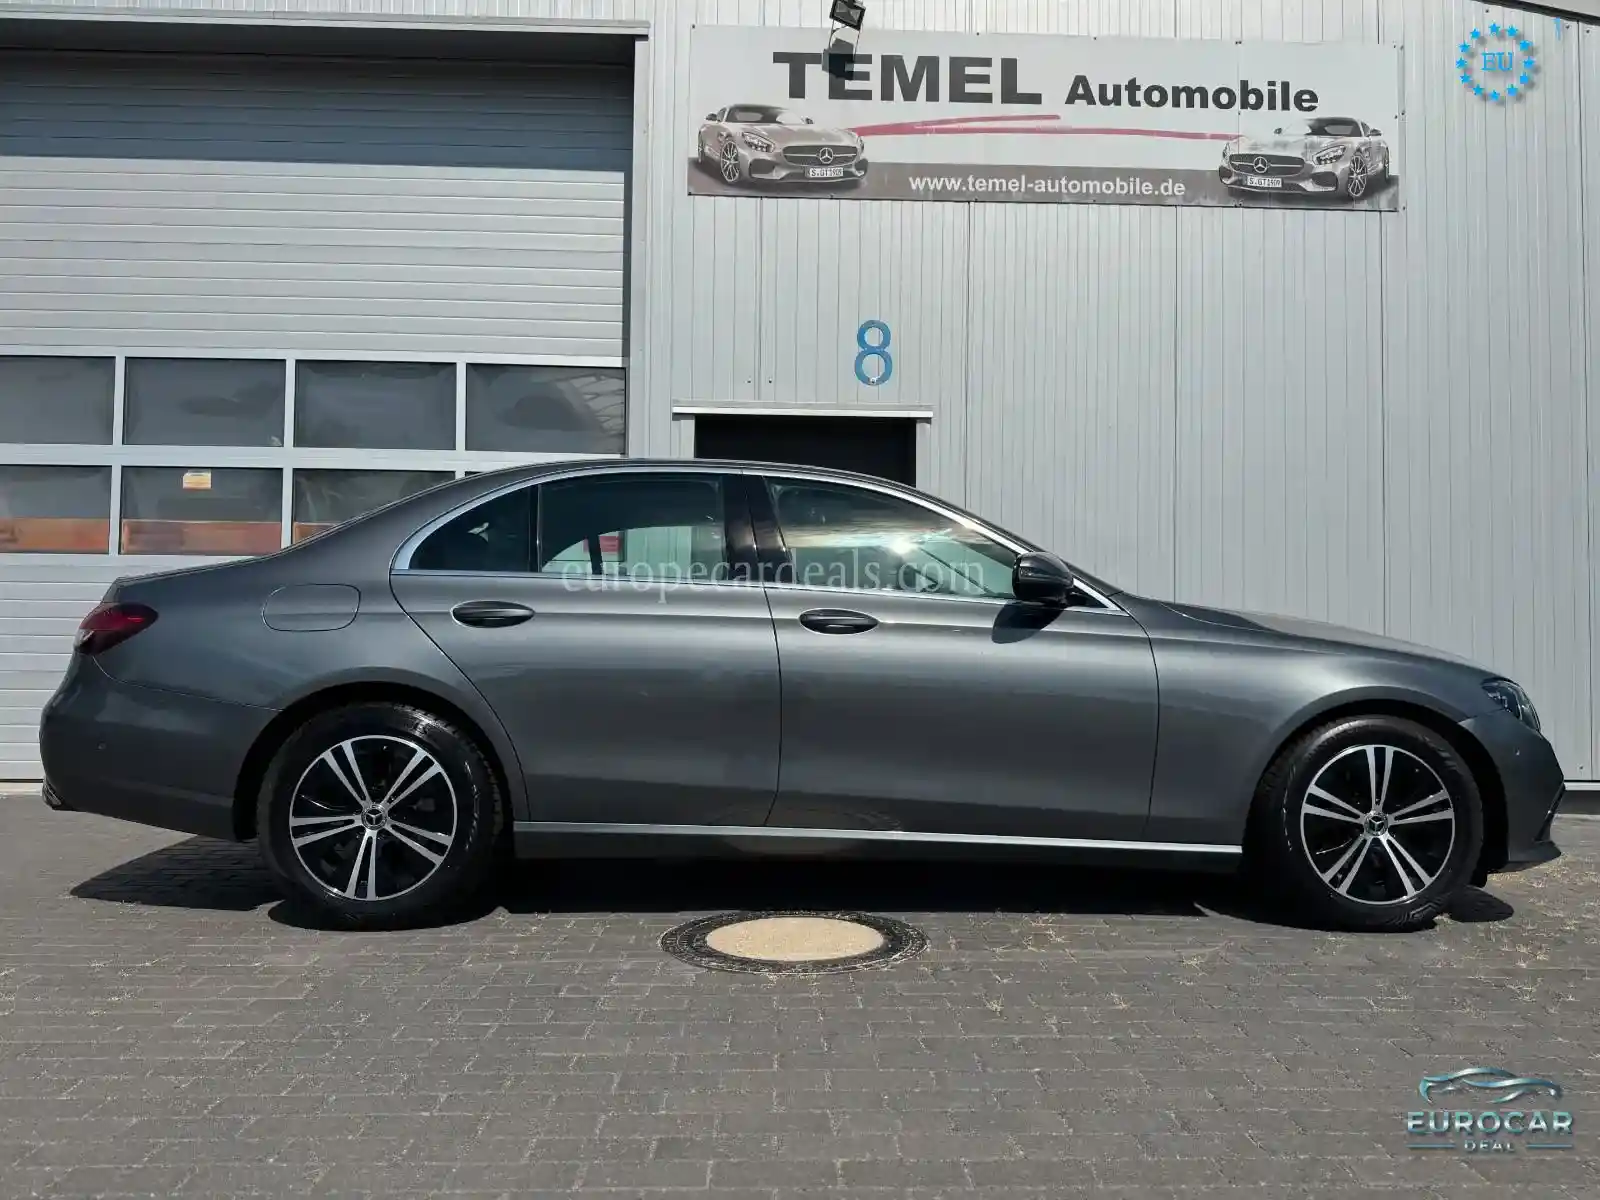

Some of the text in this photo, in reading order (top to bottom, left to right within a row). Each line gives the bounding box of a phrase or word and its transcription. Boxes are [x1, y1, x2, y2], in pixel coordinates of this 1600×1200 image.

[772, 52, 1319, 112] TEMEL Automobile
[909, 175, 1186, 196] www.temel-automobile.de
[854, 319, 893, 386] 8
